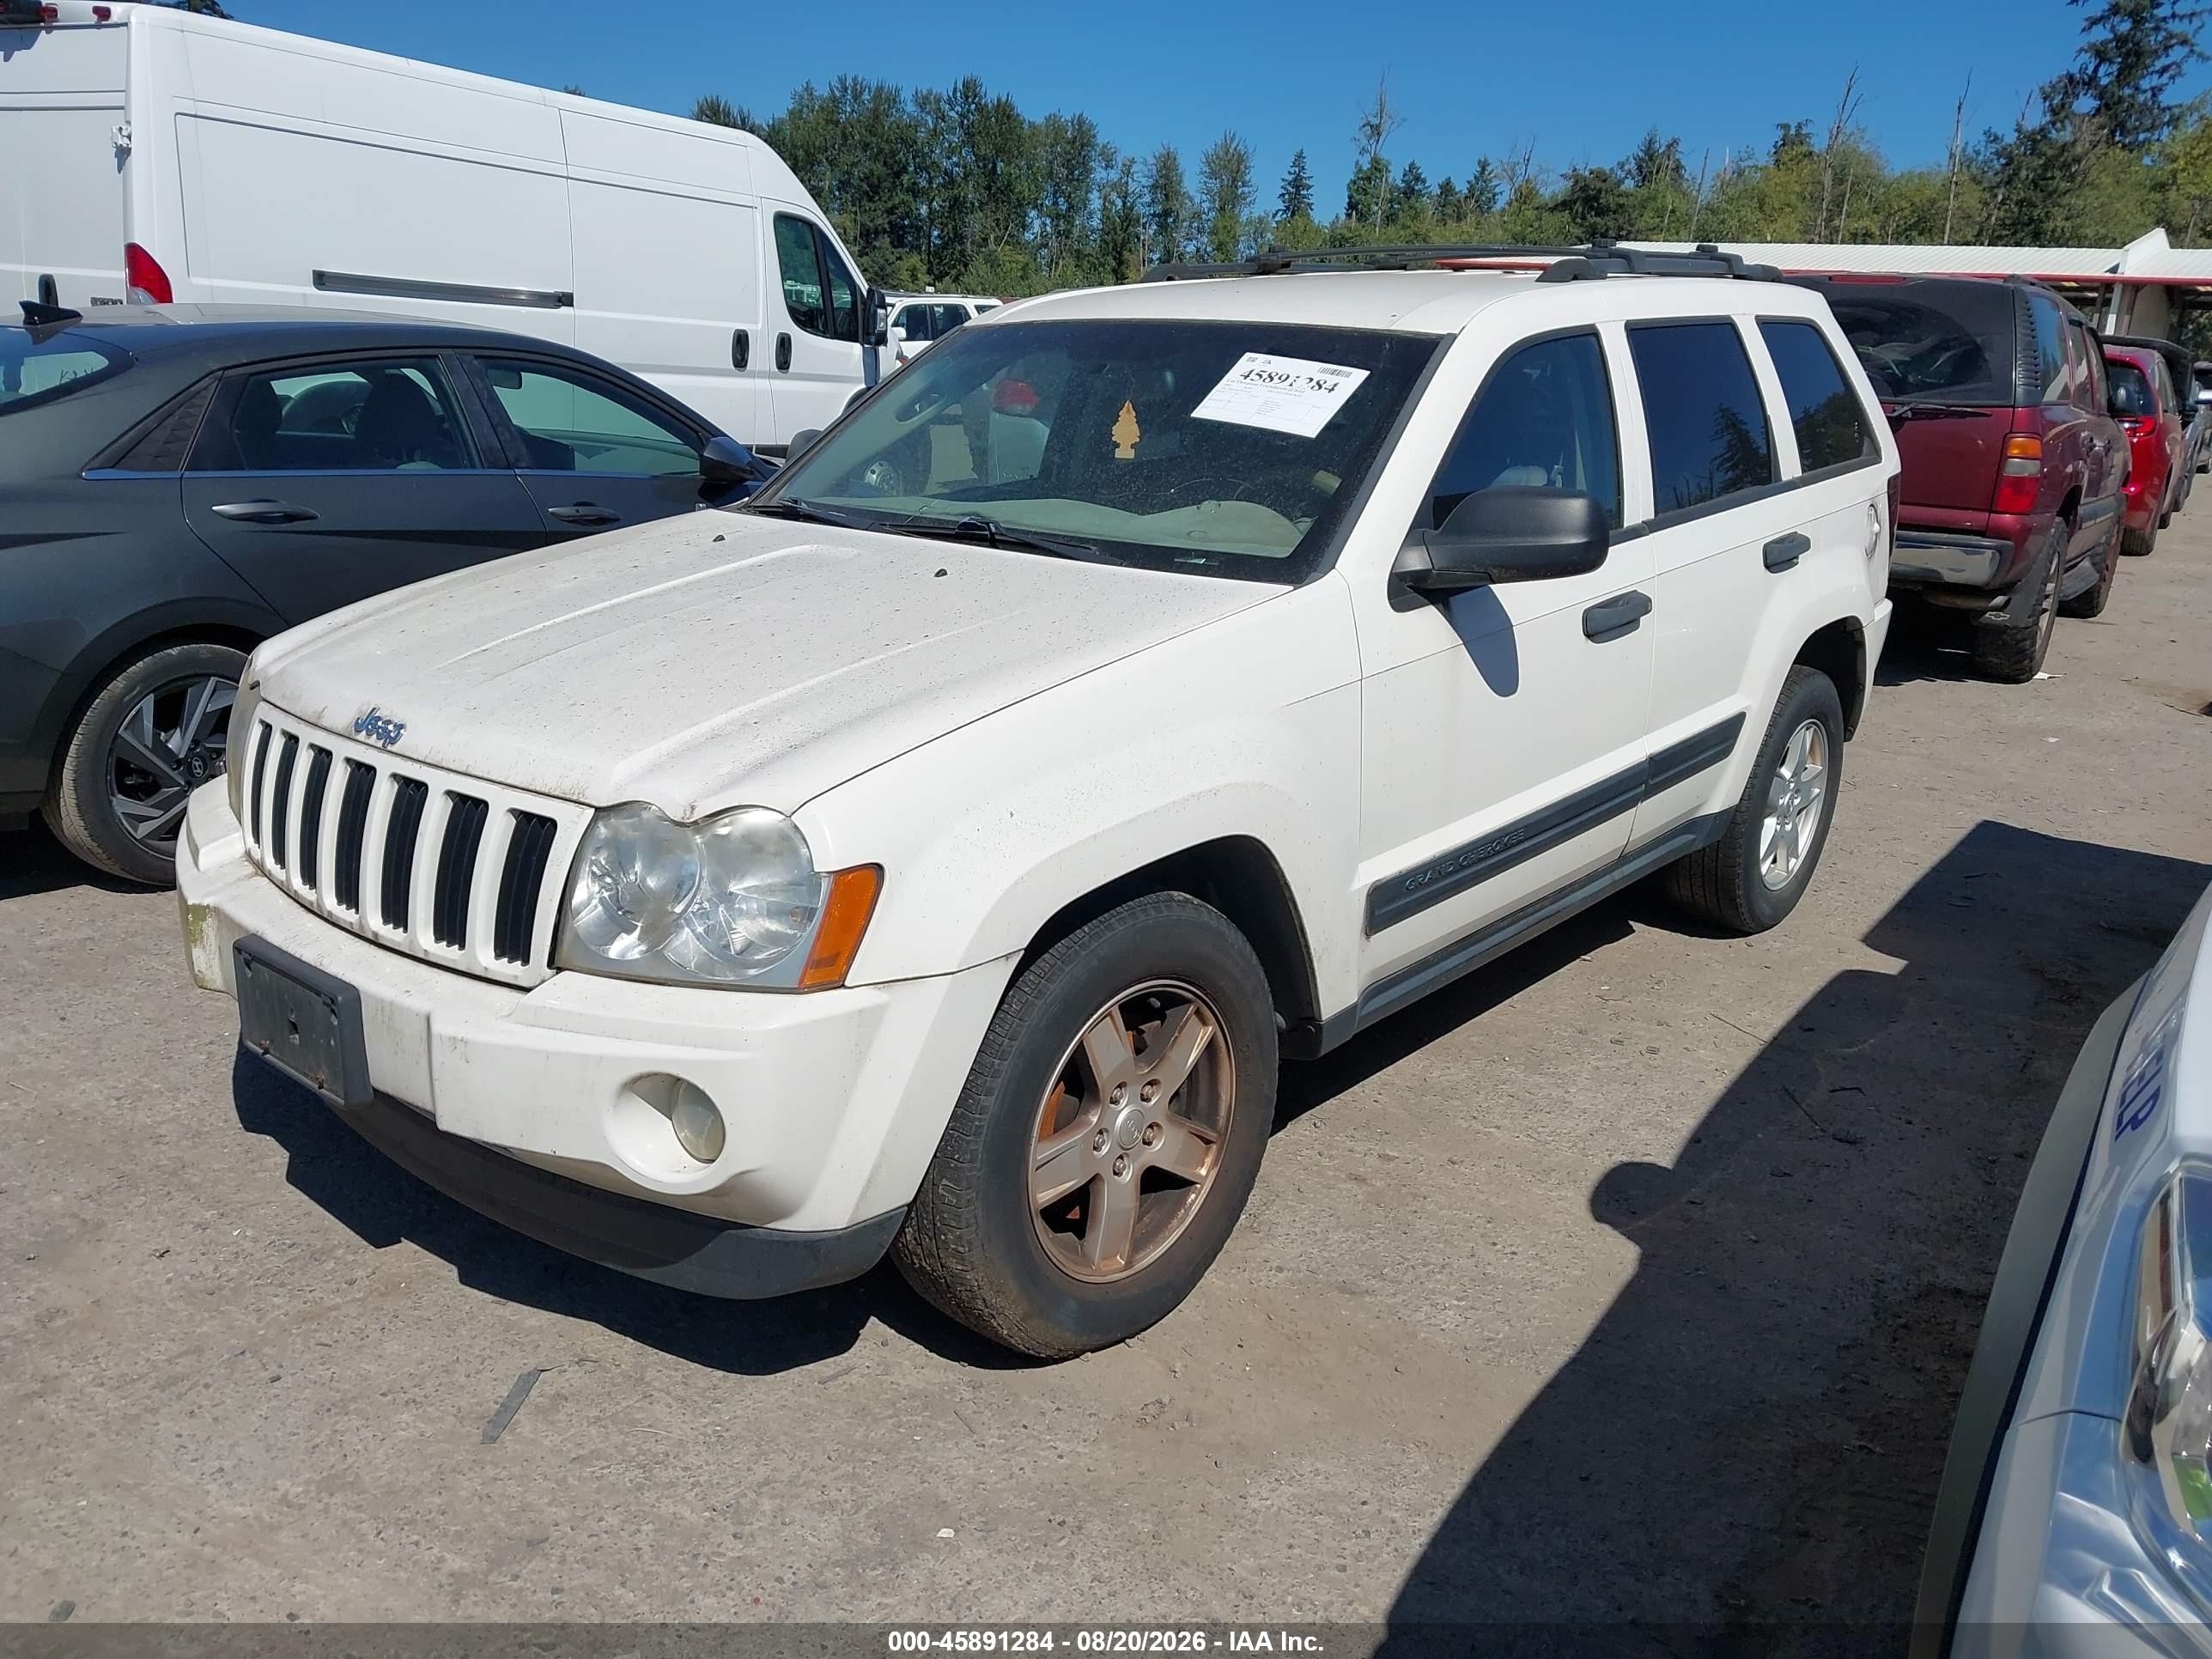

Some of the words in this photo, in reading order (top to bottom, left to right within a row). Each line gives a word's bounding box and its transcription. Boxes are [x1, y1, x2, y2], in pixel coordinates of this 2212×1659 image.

[353, 707, 407, 749] Jeep
[1404, 860, 1455, 892] GRAND
[1458, 829, 1526, 867] CHEROKEE
